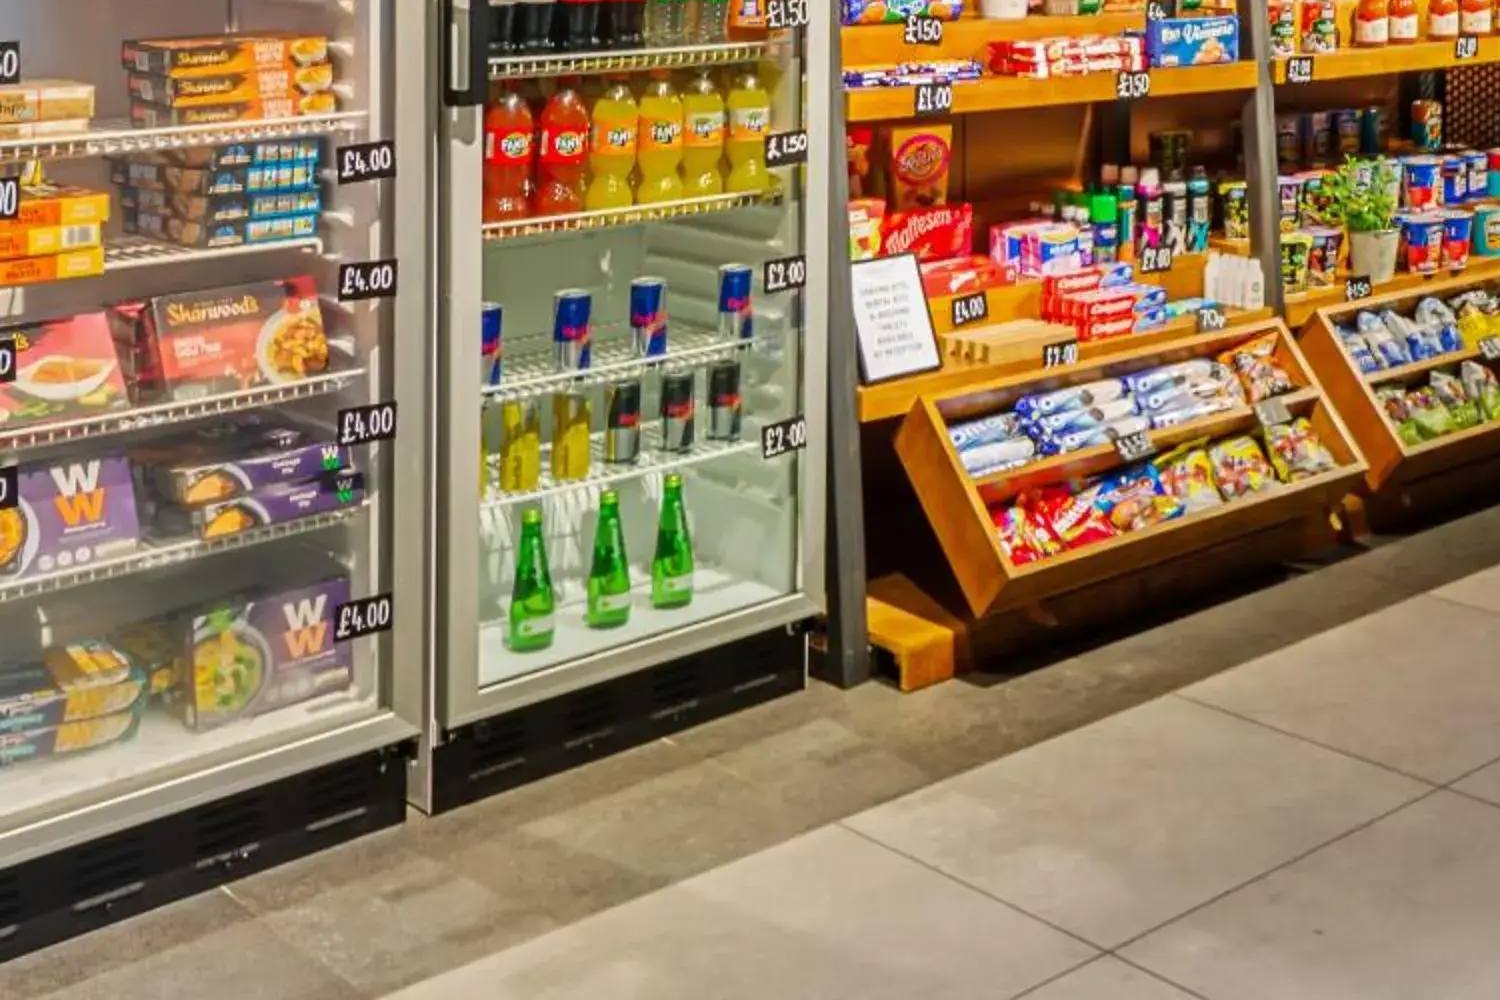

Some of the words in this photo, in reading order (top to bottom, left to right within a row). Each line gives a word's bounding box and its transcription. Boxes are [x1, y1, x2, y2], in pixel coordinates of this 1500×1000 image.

[905, 15, 942, 43] £1.50
[341, 146, 392, 178] £4.00
[767, 134, 807, 160] £1.50
[885, 209, 952, 254] Maltesers
[341, 266, 393, 296] £4.00
[766, 261, 804, 290] £2.00
[166, 296, 259, 326] Sharwood's
[341, 407, 392, 441] £4.00
[766, 420, 806, 457] £2.00
[337, 601, 390, 637] £4.00
